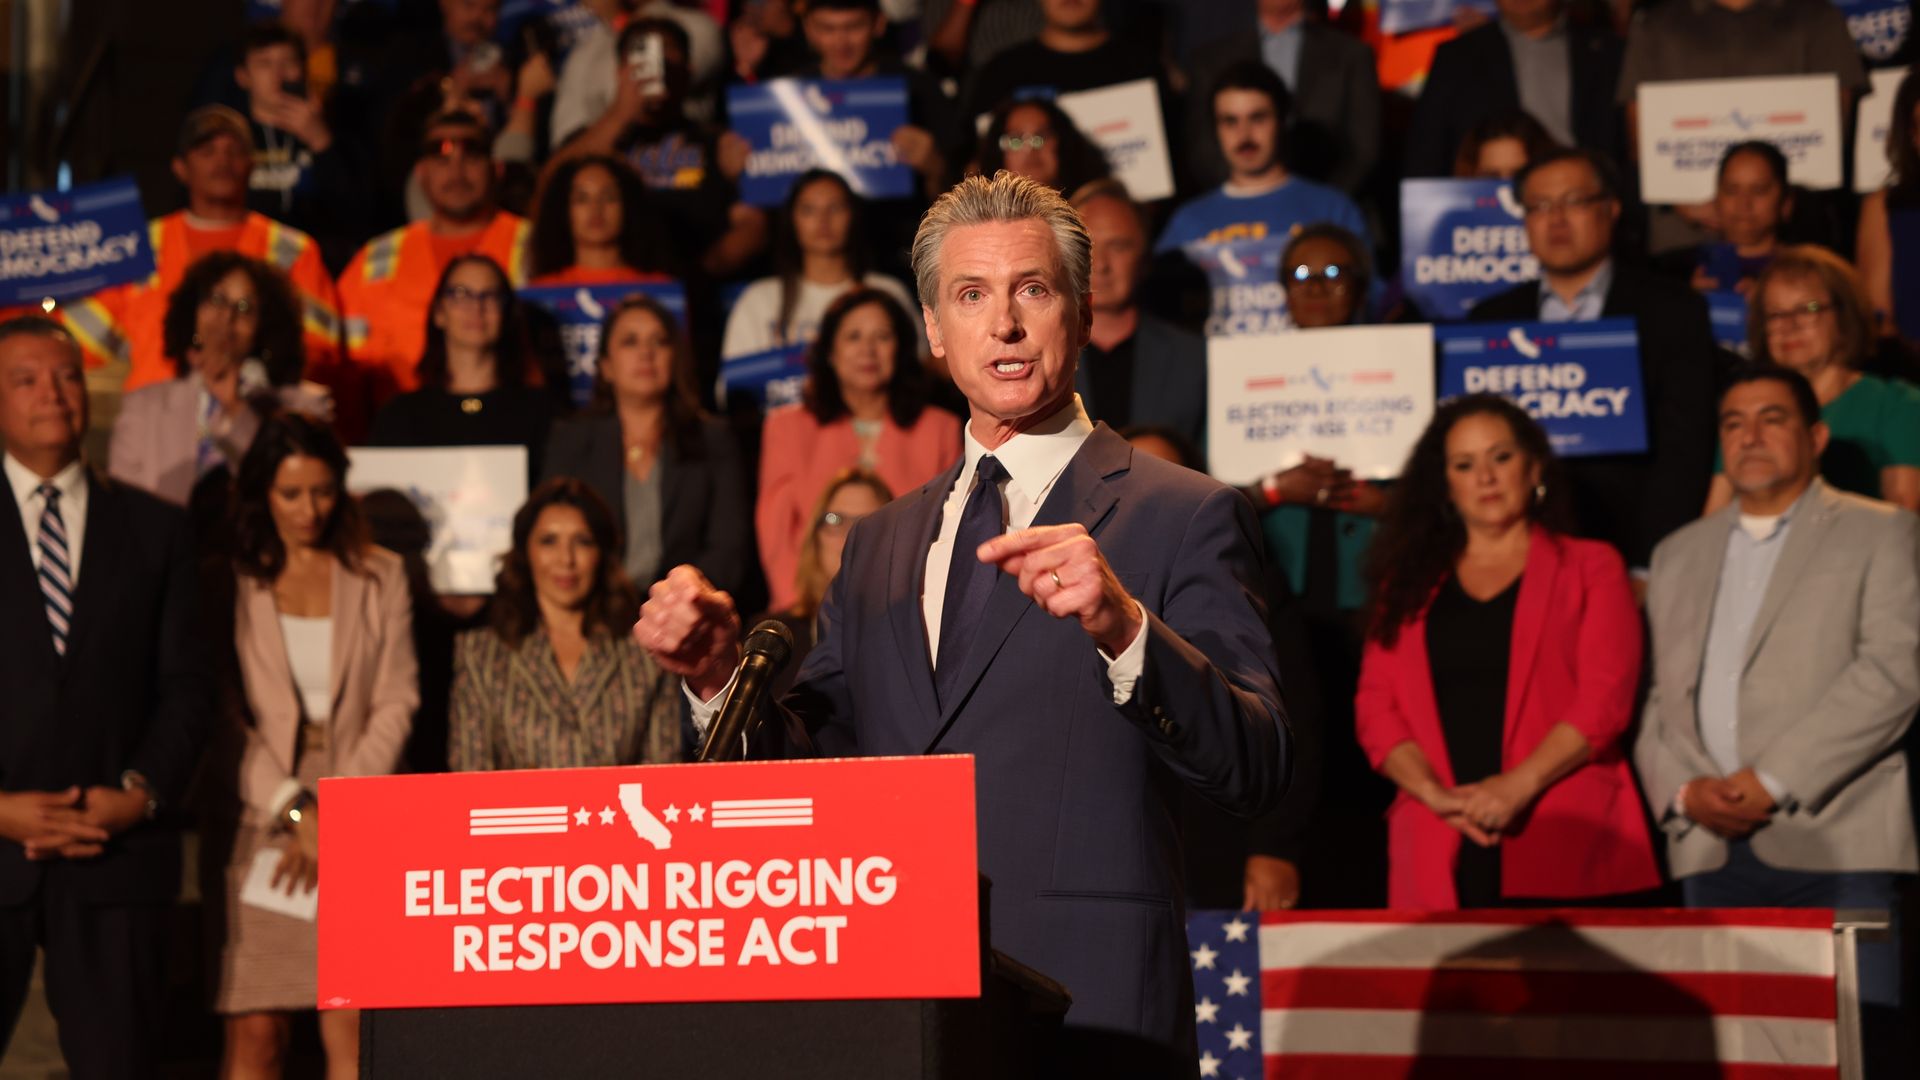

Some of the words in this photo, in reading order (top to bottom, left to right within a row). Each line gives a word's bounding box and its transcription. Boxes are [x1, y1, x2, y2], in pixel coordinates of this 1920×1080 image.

[0, 231, 138, 278] MOCRACY
[1453, 226, 1530, 255] DEFE
[1416, 255, 1540, 284] DEMOCR
[1464, 363, 1586, 393] DEFEND
[1227, 401, 1319, 424] ELECTION
[1516, 386, 1630, 419] CRACY
[1246, 421, 1346, 441] RESPNSE
[406, 864, 649, 916] ELECTION
[665, 857, 897, 910] RIGGING
[454, 918, 725, 971] RESPONSE
[738, 916, 848, 965] ACT
